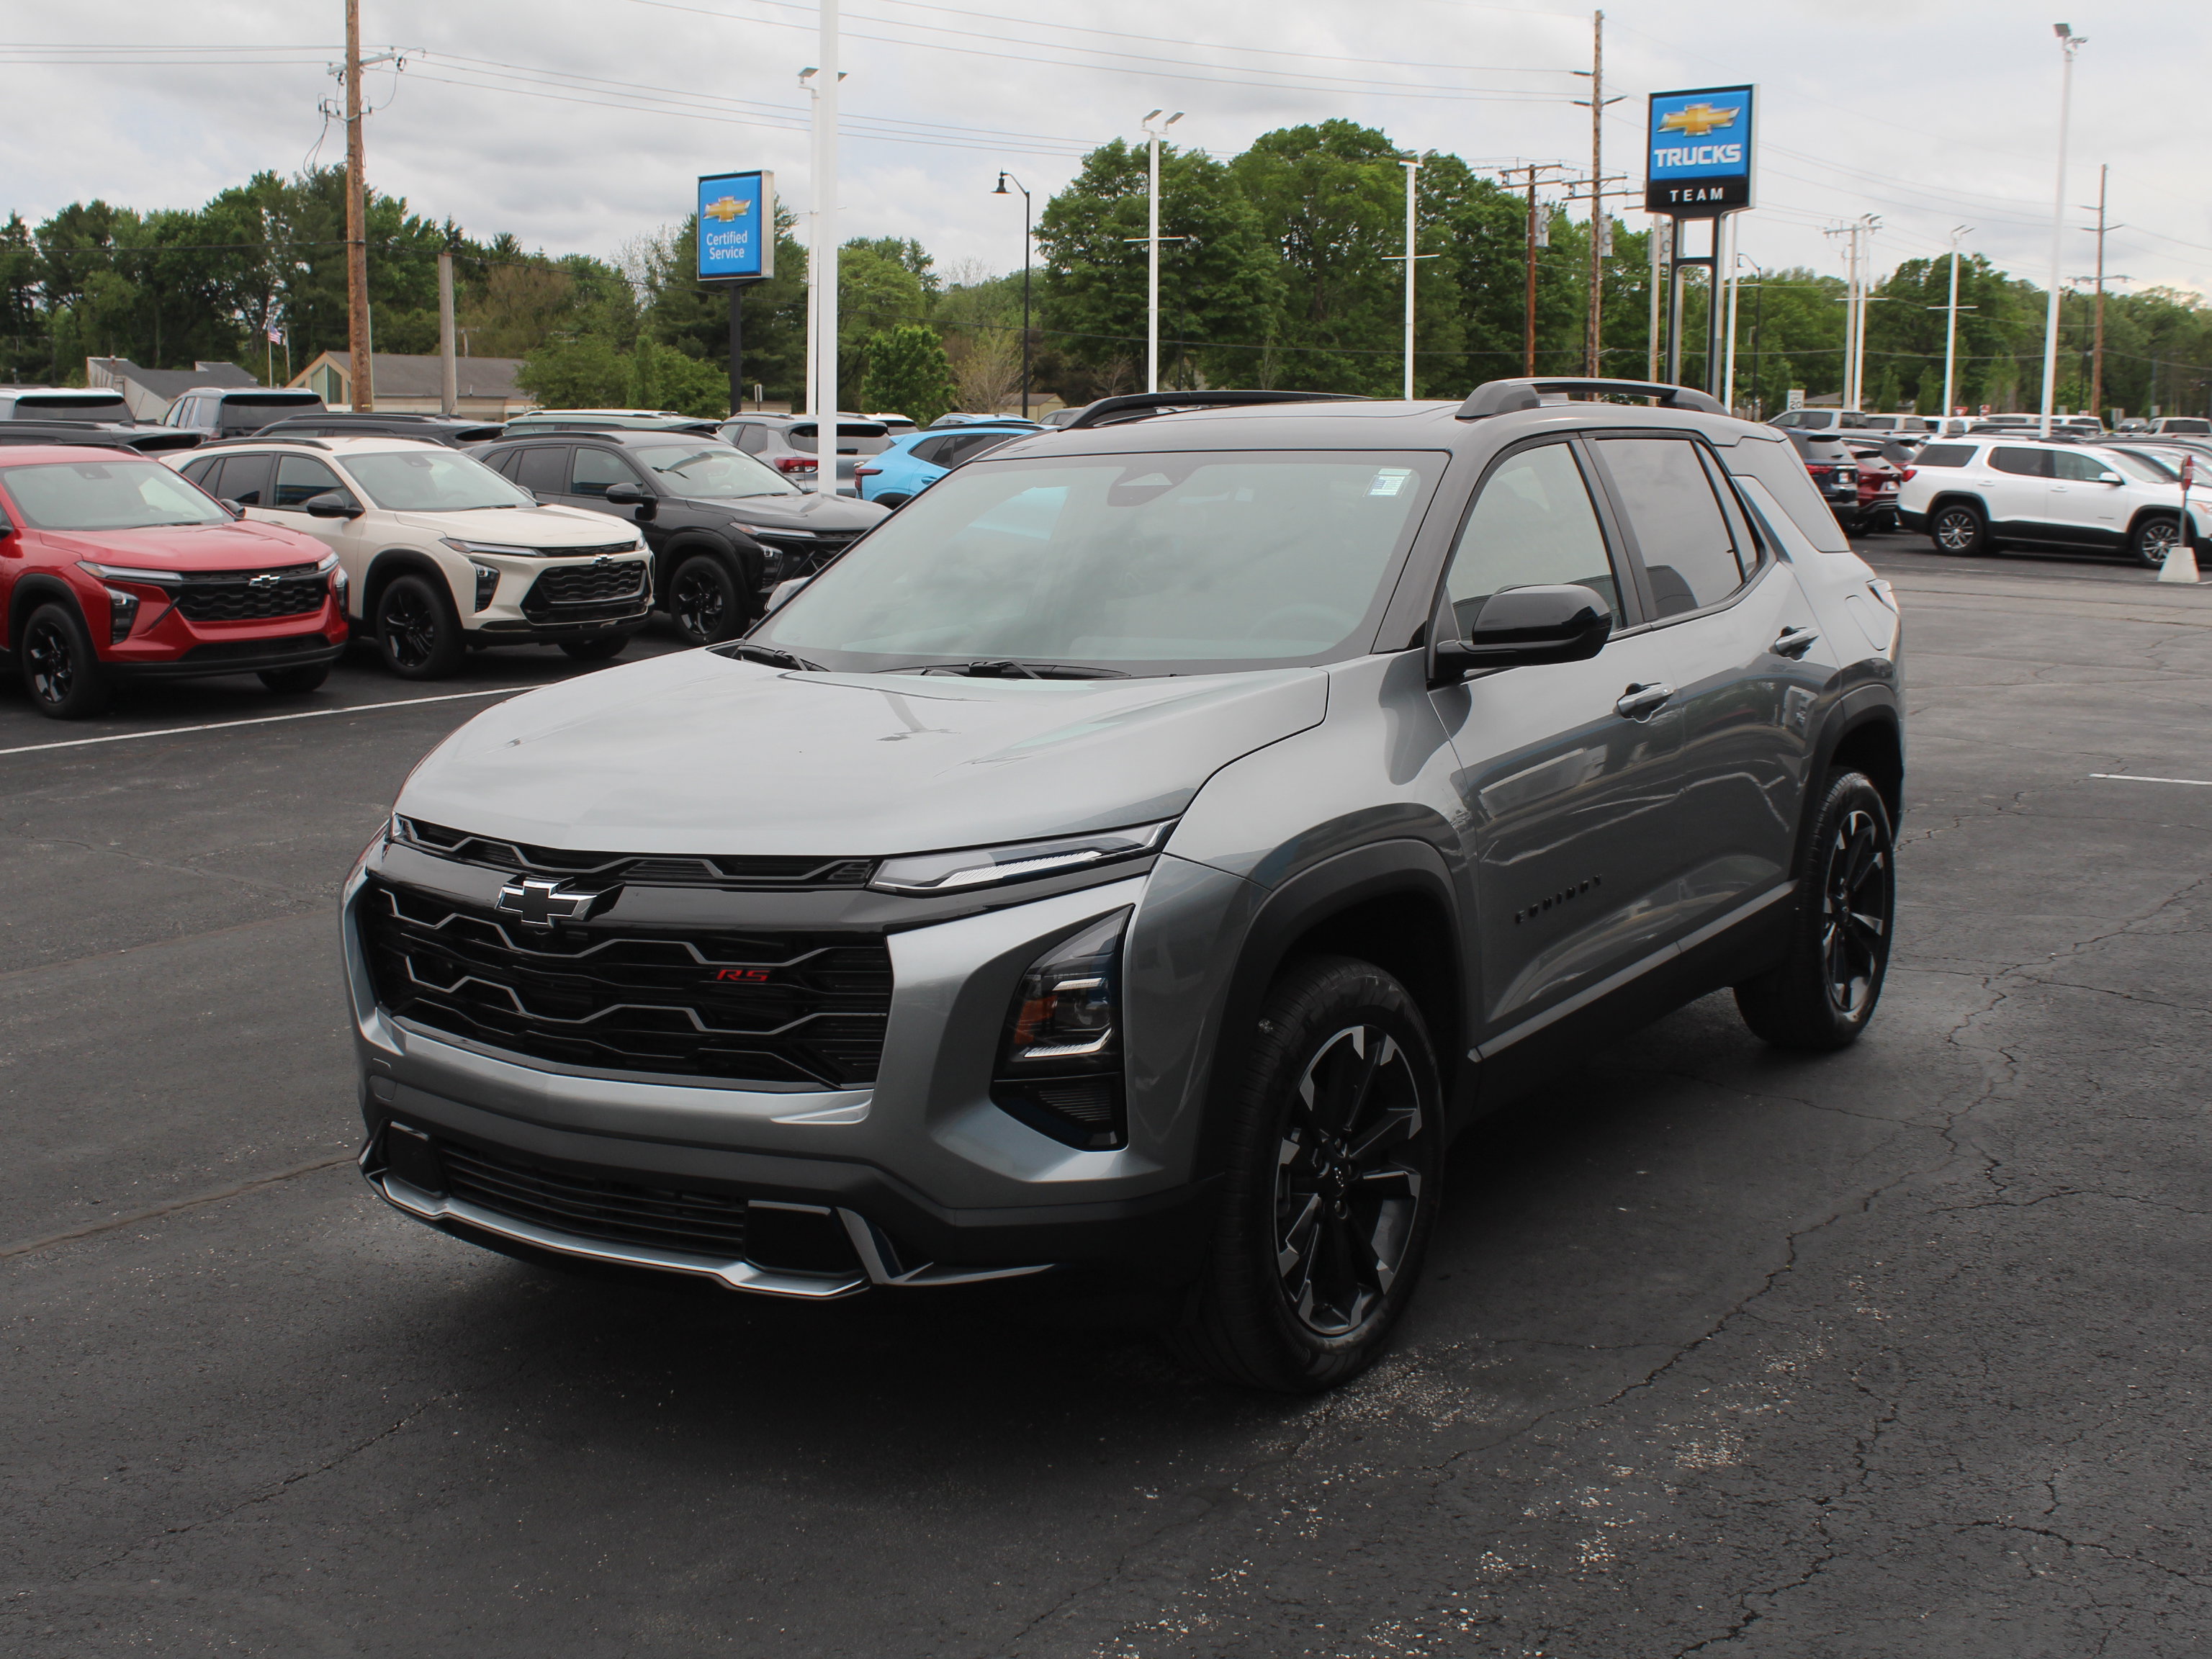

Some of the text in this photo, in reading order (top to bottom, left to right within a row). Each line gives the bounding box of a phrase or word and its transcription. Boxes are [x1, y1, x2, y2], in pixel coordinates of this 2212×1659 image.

[1654, 144, 1742, 168] TRUCKS
[1670, 187, 1724, 202] TEAM
[706, 230, 747, 246] Certified
[709, 246, 745, 260] Service
[716, 968, 770, 981] RS
